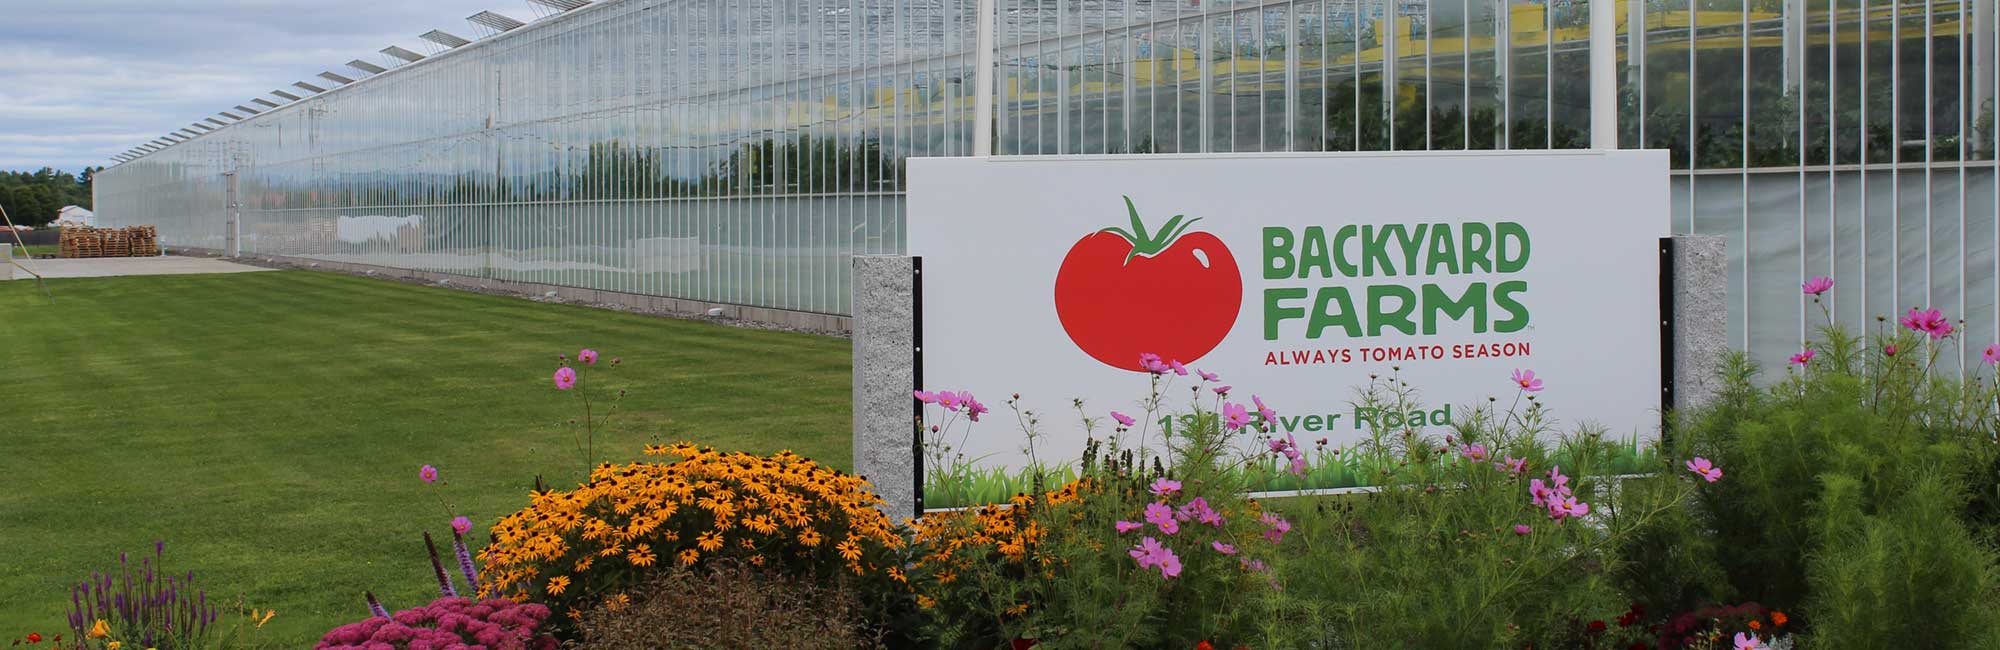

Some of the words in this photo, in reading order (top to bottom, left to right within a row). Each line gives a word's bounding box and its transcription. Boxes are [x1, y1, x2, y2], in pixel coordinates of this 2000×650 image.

[1262, 221, 1531, 280] BACKYARD
[1263, 280, 1530, 341] FARMS
[1265, 349, 1351, 366] ALWAYS
[1360, 345, 1444, 362] TOMATO
[1452, 342, 1531, 358] SEASON
[1354, 403, 1451, 430] Road
